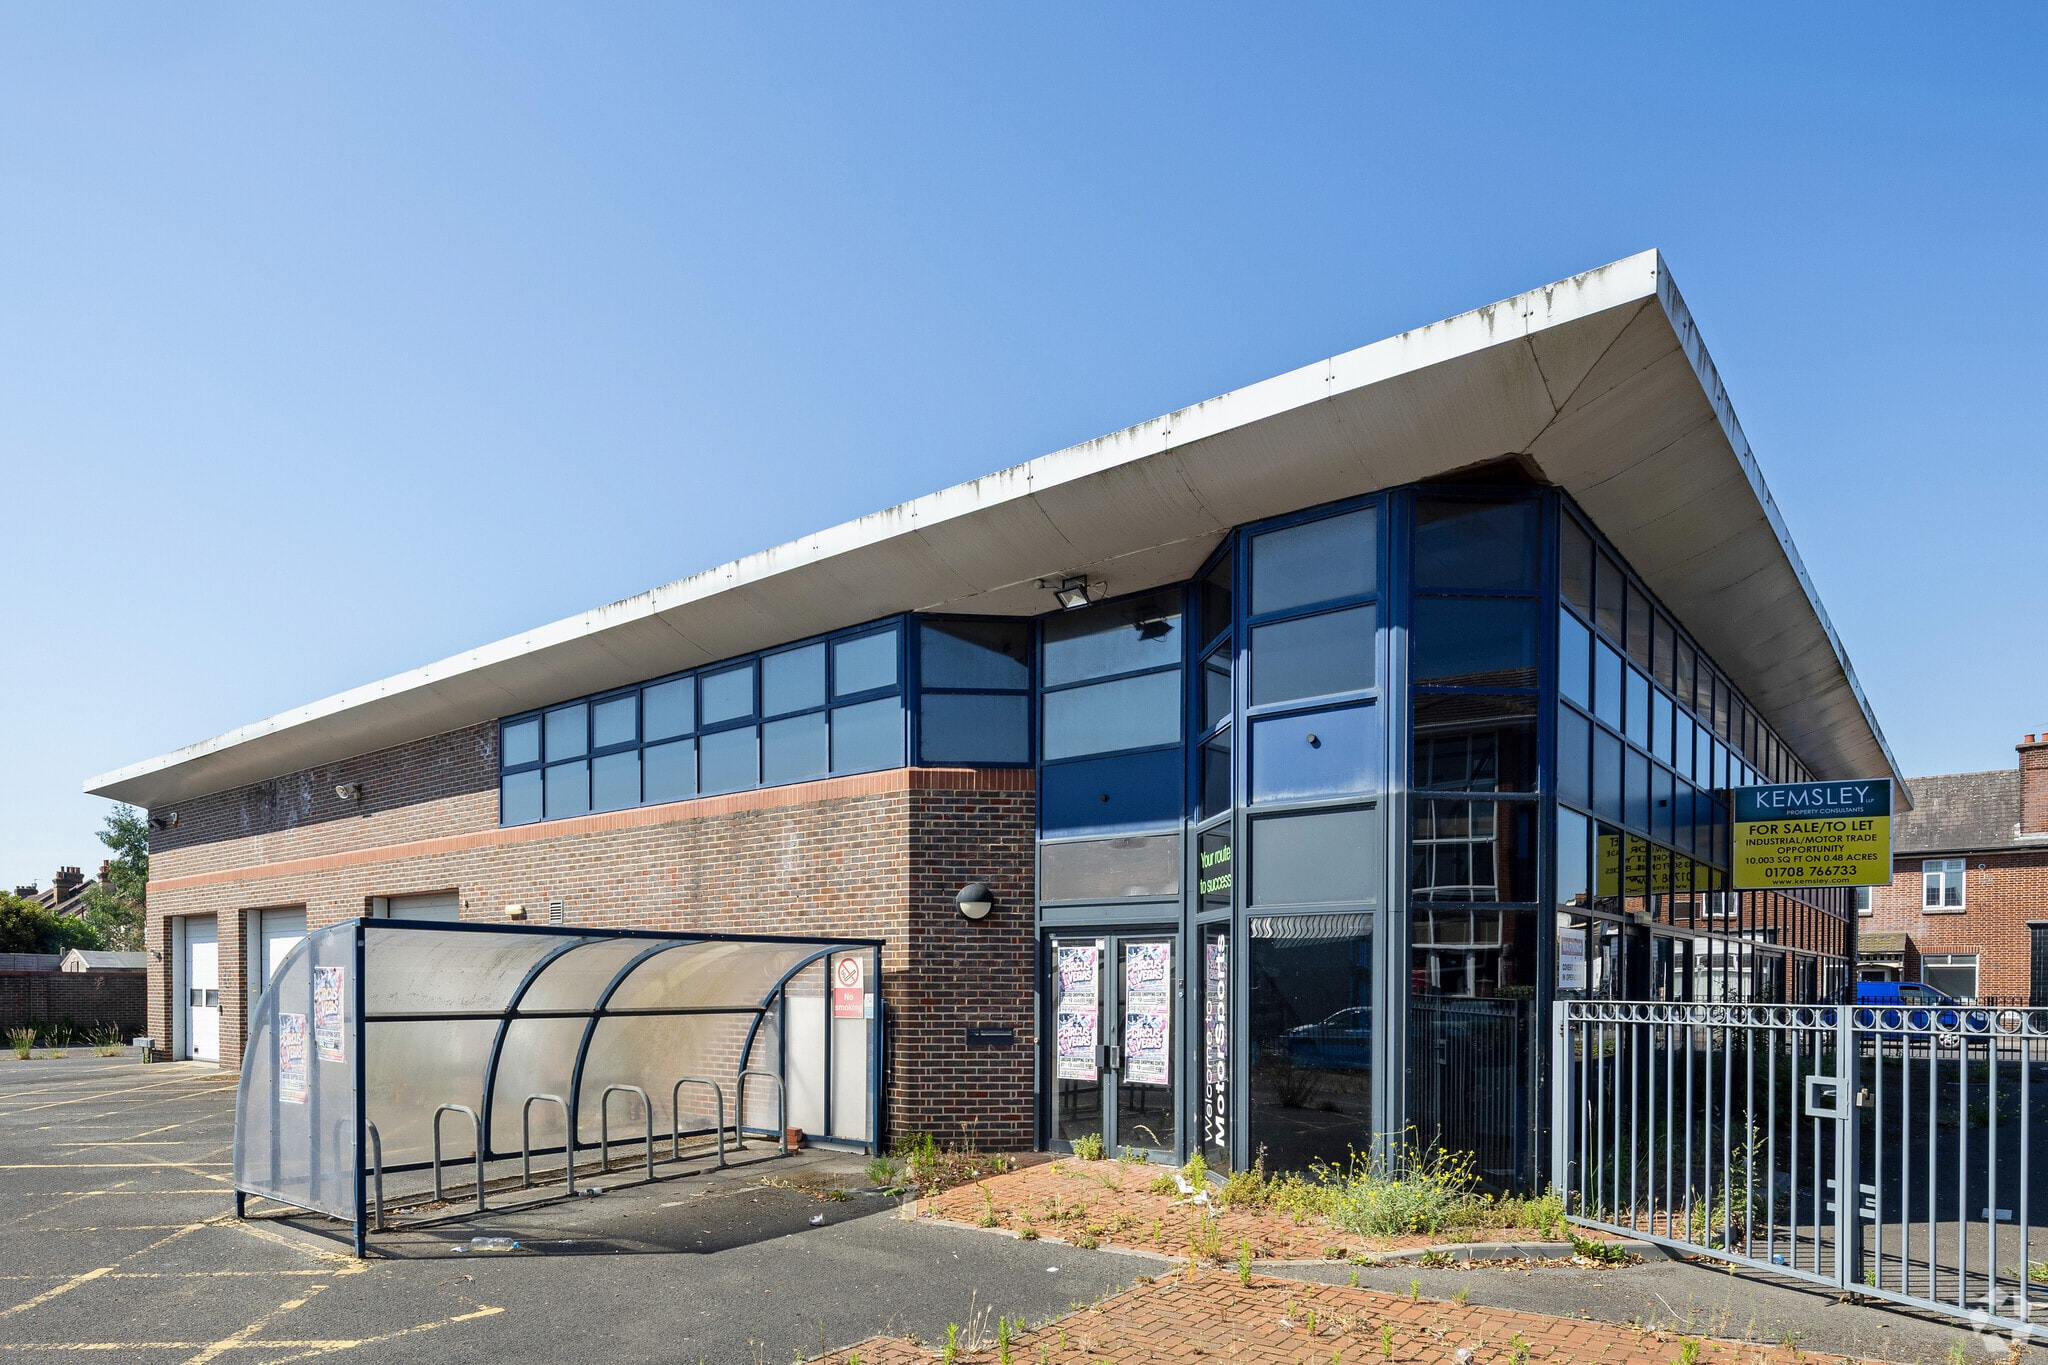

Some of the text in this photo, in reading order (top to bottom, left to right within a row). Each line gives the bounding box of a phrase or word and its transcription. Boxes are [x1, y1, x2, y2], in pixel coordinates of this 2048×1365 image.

[1756, 786, 1869, 808] KEMSLEY
[1786, 808, 1819, 816] PROPERTY
[1749, 820, 1874, 835] FOR SALE/TO LET
[1746, 834, 1877, 846] INDUSTRIAL/MOTOR TRADE
[1777, 845, 1844, 854] OPPORTUNITY
[1200, 844, 1231, 868] Your route
[1745, 857, 1775, 865] 10,003
[1777, 856, 1791, 864] SQ
[1793, 855, 1802, 863] FT
[1824, 854, 1843, 862] 0.48
[1846, 853, 1878, 861] ACRES
[1765, 865, 1857, 878] 01708 766733
[1200, 873, 1232, 894] to success
[1772, 877, 1850, 886] www.kemsley.com
[1063, 961, 1091, 971] CIRCUS
[1132, 959, 1161, 970] CIRCUS
[1068, 970, 1092, 983] VEGAS
[1137, 969, 1163, 982] VEGAS
[843, 993, 854, 1001] No
[834, 1003, 862, 1014] smoking
[1063, 1026, 1091, 1037] CIRCUS
[1131, 1027, 1160, 1038] CIRCUS
[1068, 1036, 1091, 1049] VEGAS
[1136, 1037, 1162, 1050] VEGAS
[1215, 934, 1225, 1147] MotorSports
[1204, 1000, 1213, 1142] Welcome to
